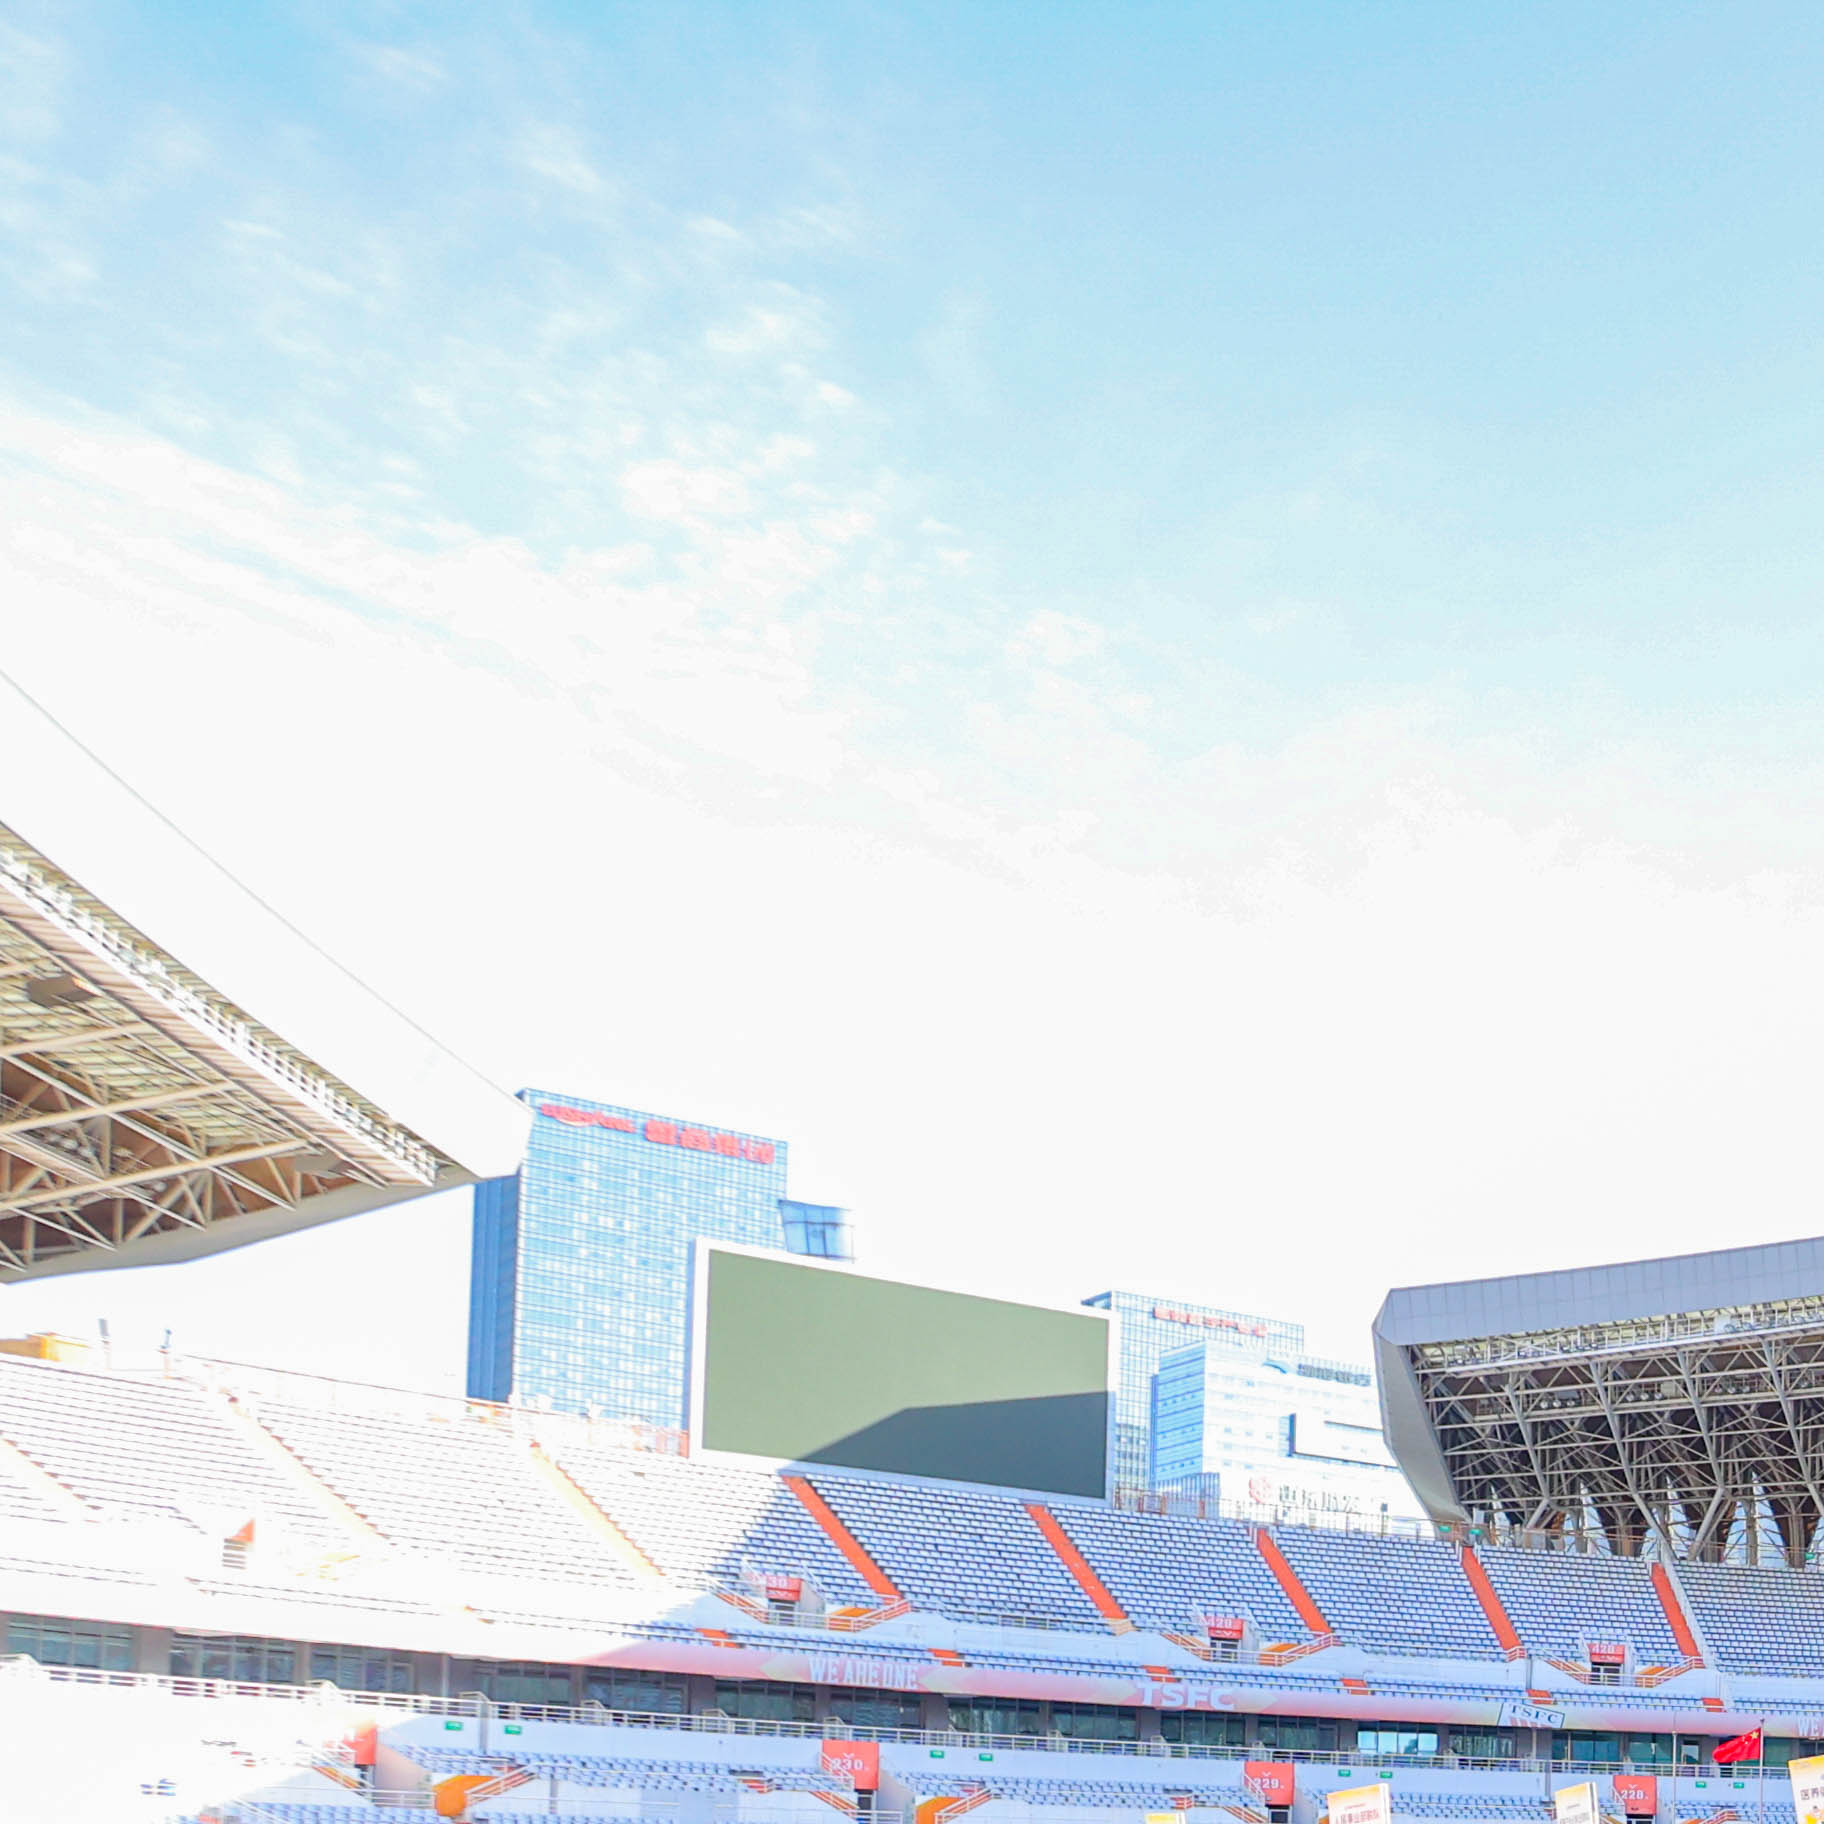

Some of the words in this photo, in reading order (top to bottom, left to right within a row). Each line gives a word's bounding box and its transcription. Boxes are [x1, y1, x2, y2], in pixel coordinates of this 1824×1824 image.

[808, 1656, 838, 1682] WE
[845, 1658, 878, 1686] ARE
[880, 1661, 917, 1689] ONE
[1141, 1683, 1234, 1710] TSFC
[1509, 1703, 1560, 1724] TSFC
[1799, 1719, 1820, 1738] WE
